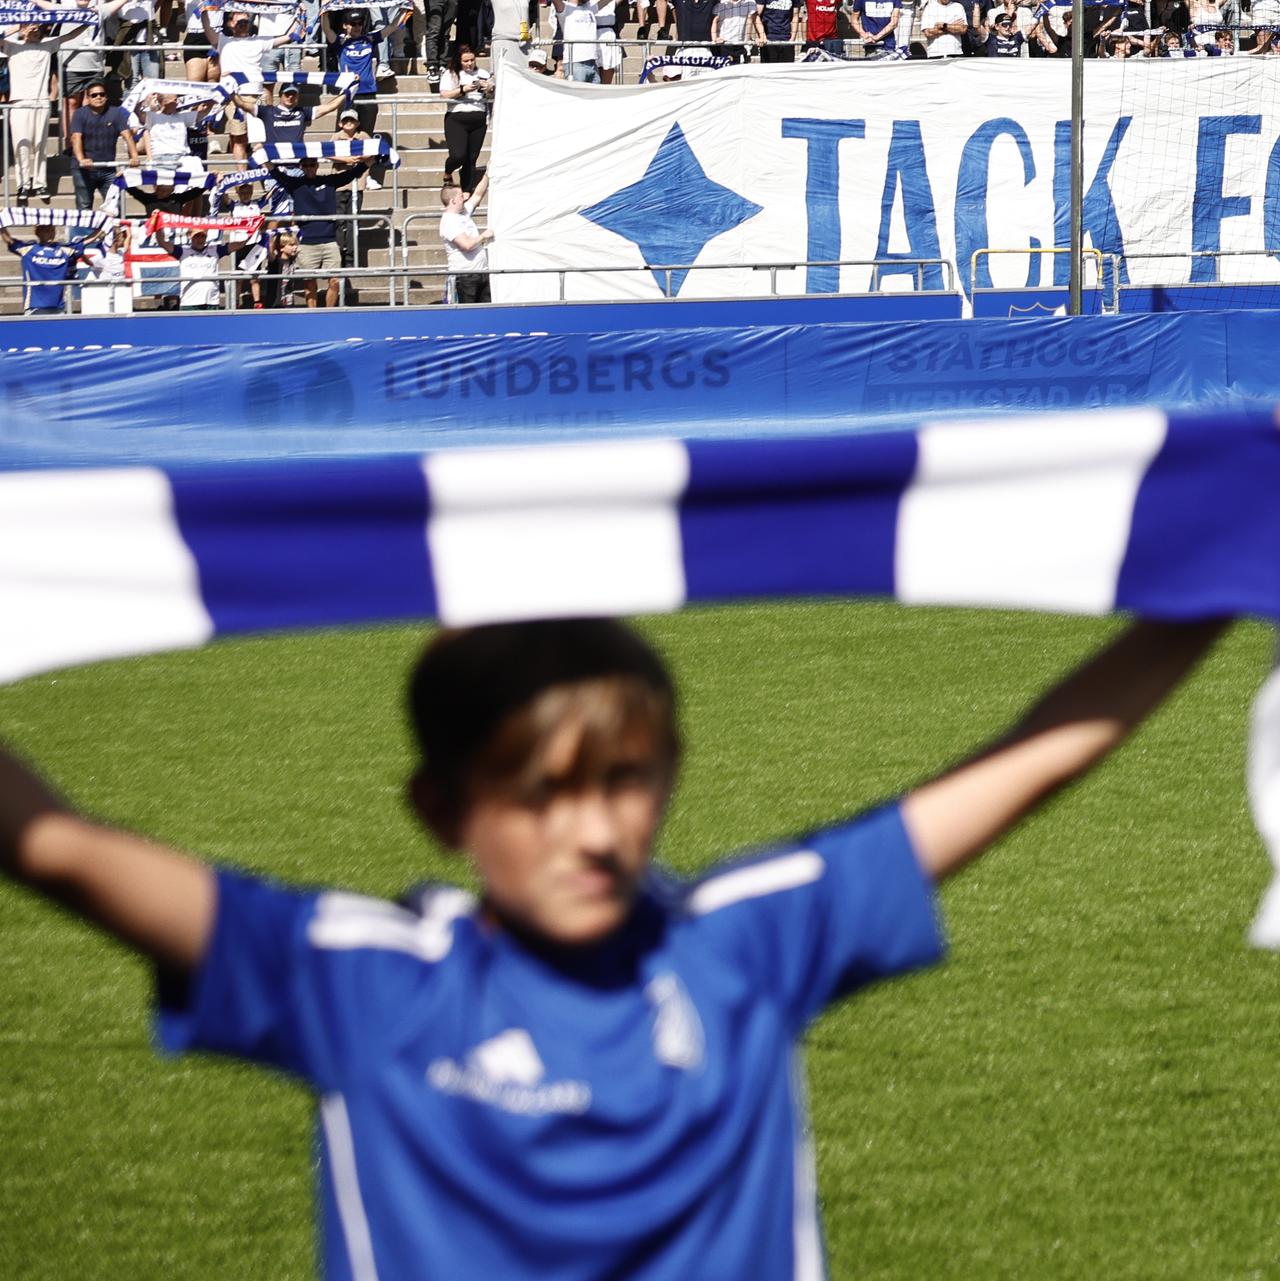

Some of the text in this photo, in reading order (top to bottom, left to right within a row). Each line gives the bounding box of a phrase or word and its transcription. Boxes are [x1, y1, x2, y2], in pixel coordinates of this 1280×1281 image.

[647, 55, 733, 71] NORRKÖPING
[781, 114, 1131, 306] TACK
[383, 348, 731, 402] LUNDBERGS
[885, 331, 1135, 375] STÅTHÖGA
